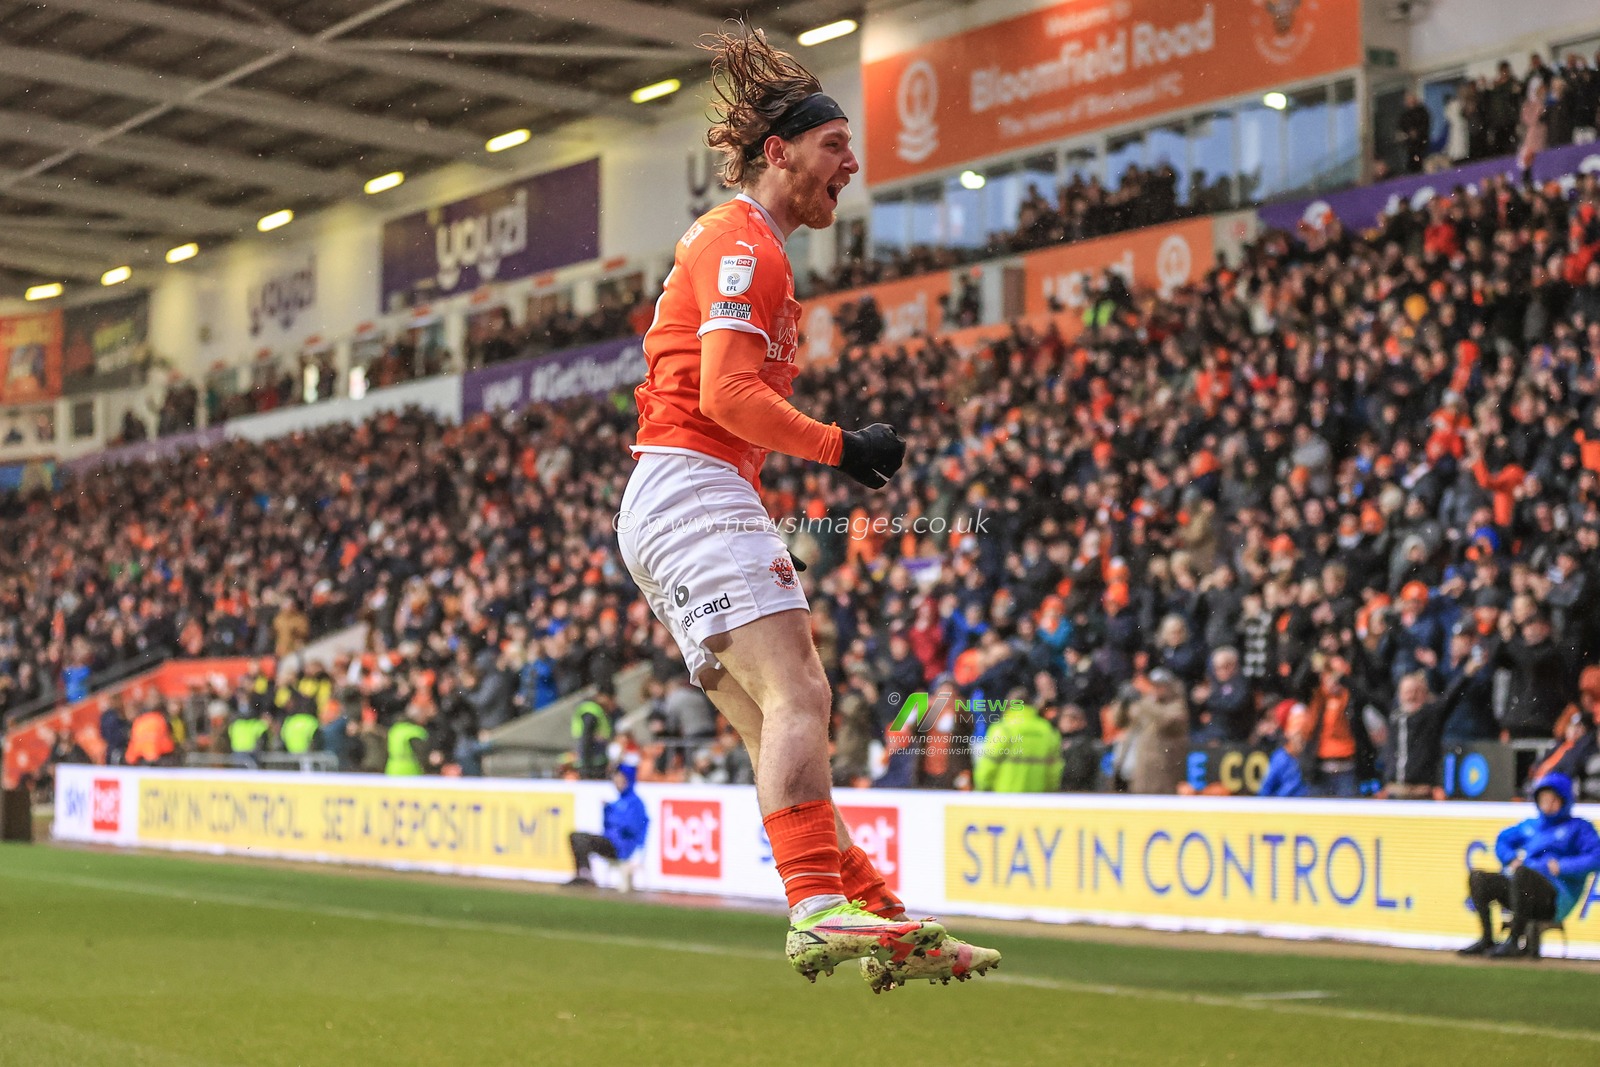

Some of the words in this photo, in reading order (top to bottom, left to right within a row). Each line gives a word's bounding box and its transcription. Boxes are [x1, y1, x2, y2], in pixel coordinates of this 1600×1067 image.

[970, 29, 1127, 113] Bloomfield
[1131, 4, 1216, 69] Road
[737, 259, 752, 267] bet
[727, 302, 752, 312] TODAY
[736, 311, 750, 319] DAY
[141, 787, 181, 832] STAY
[322, 796, 356, 843] SET
[380, 799, 485, 850] DEPOSIT
[490, 805, 563, 858] LIMIT
[662, 810, 721, 865] bet
[849, 815, 895, 876] et
[962, 824, 1063, 889] STAY
[1077, 828, 1124, 890] IN
[1143, 830, 1413, 911] CONTROL.
